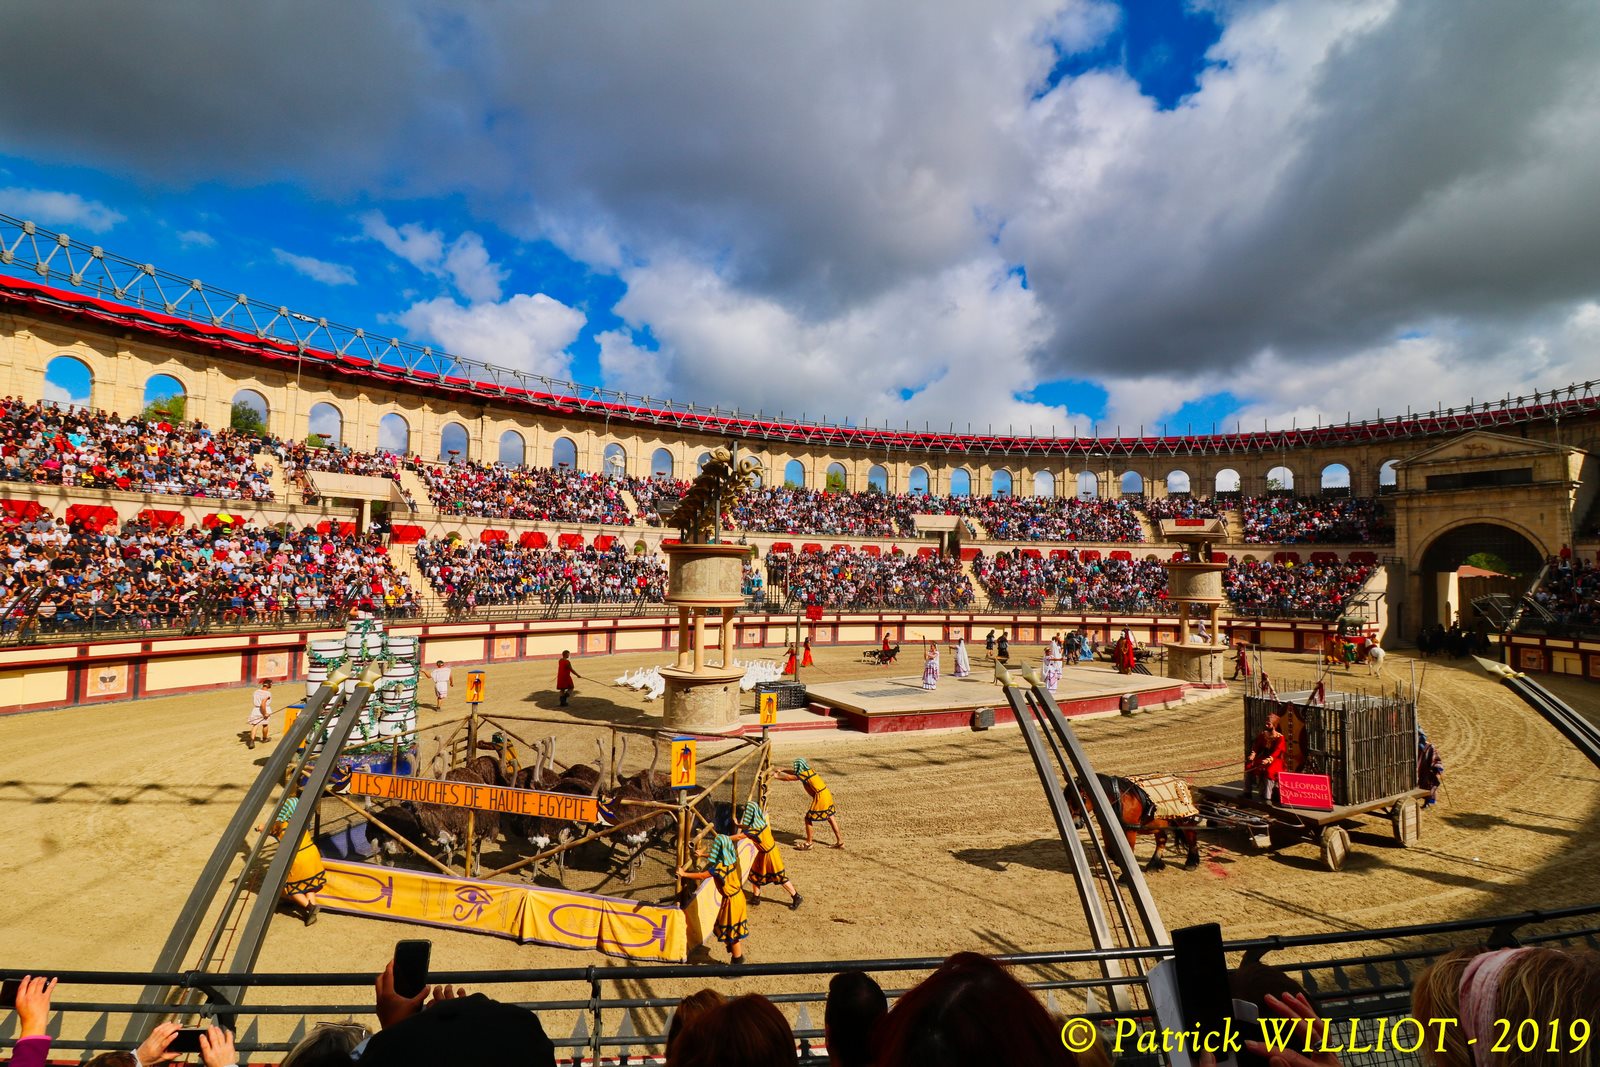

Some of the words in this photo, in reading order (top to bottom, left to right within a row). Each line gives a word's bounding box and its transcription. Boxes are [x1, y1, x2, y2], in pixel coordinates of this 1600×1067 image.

[357, 774, 383, 796] LES
[387, 777, 460, 805] AUTRUCHES
[464, 786, 484, 809] DE
